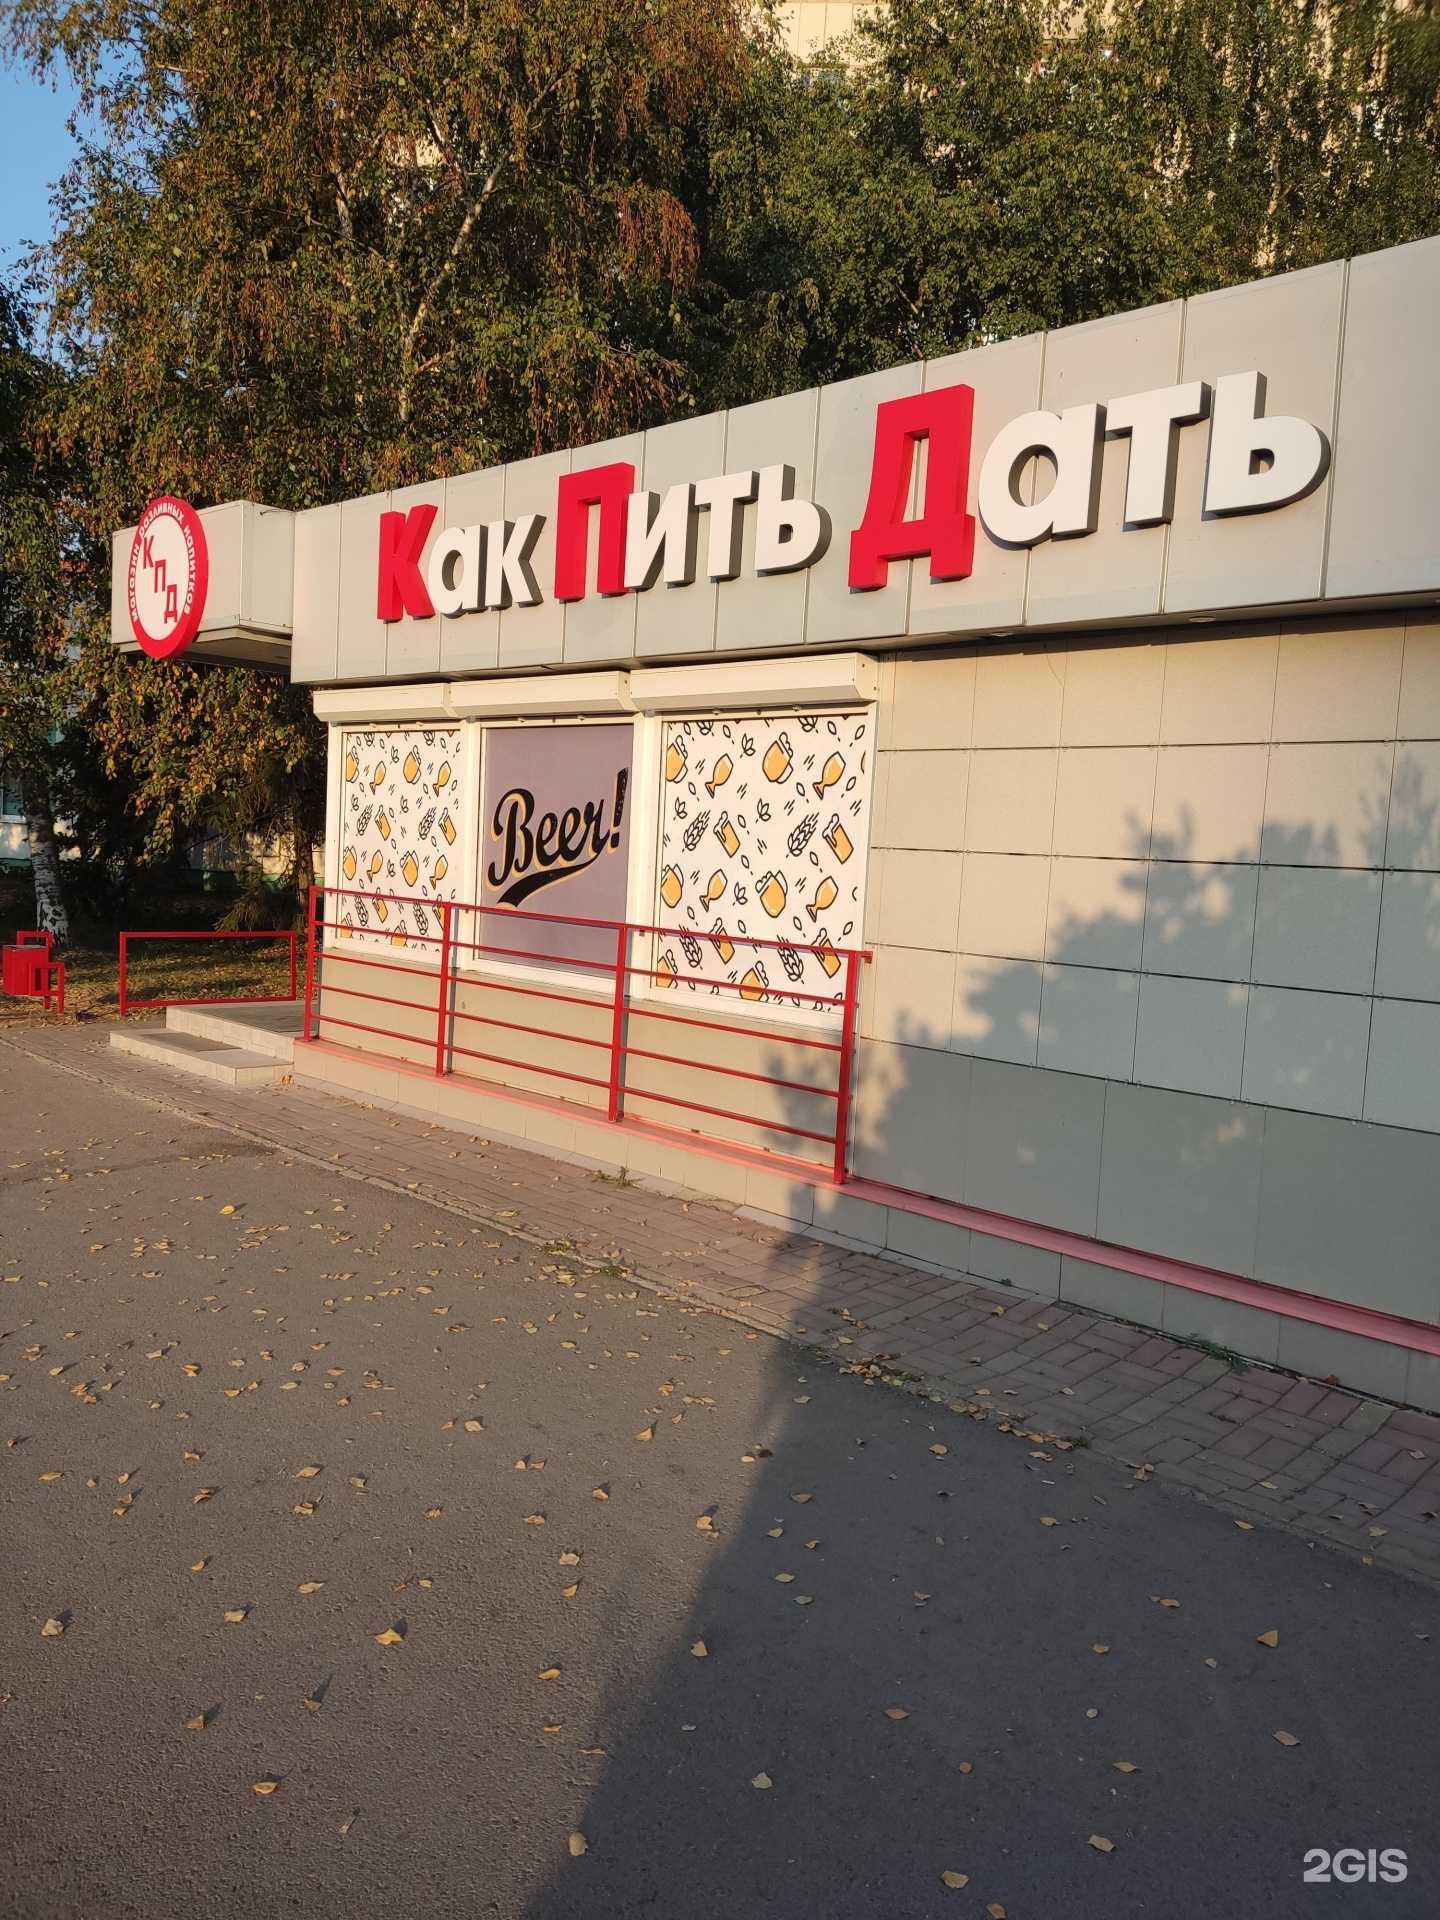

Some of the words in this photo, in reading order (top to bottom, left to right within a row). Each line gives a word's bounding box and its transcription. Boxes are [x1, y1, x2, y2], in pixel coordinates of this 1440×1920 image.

[377, 504, 546, 623] Как
[554, 462, 832, 601] Пить
[848, 371, 1331, 593] Дать
[487, 767, 629, 888] Beer!
